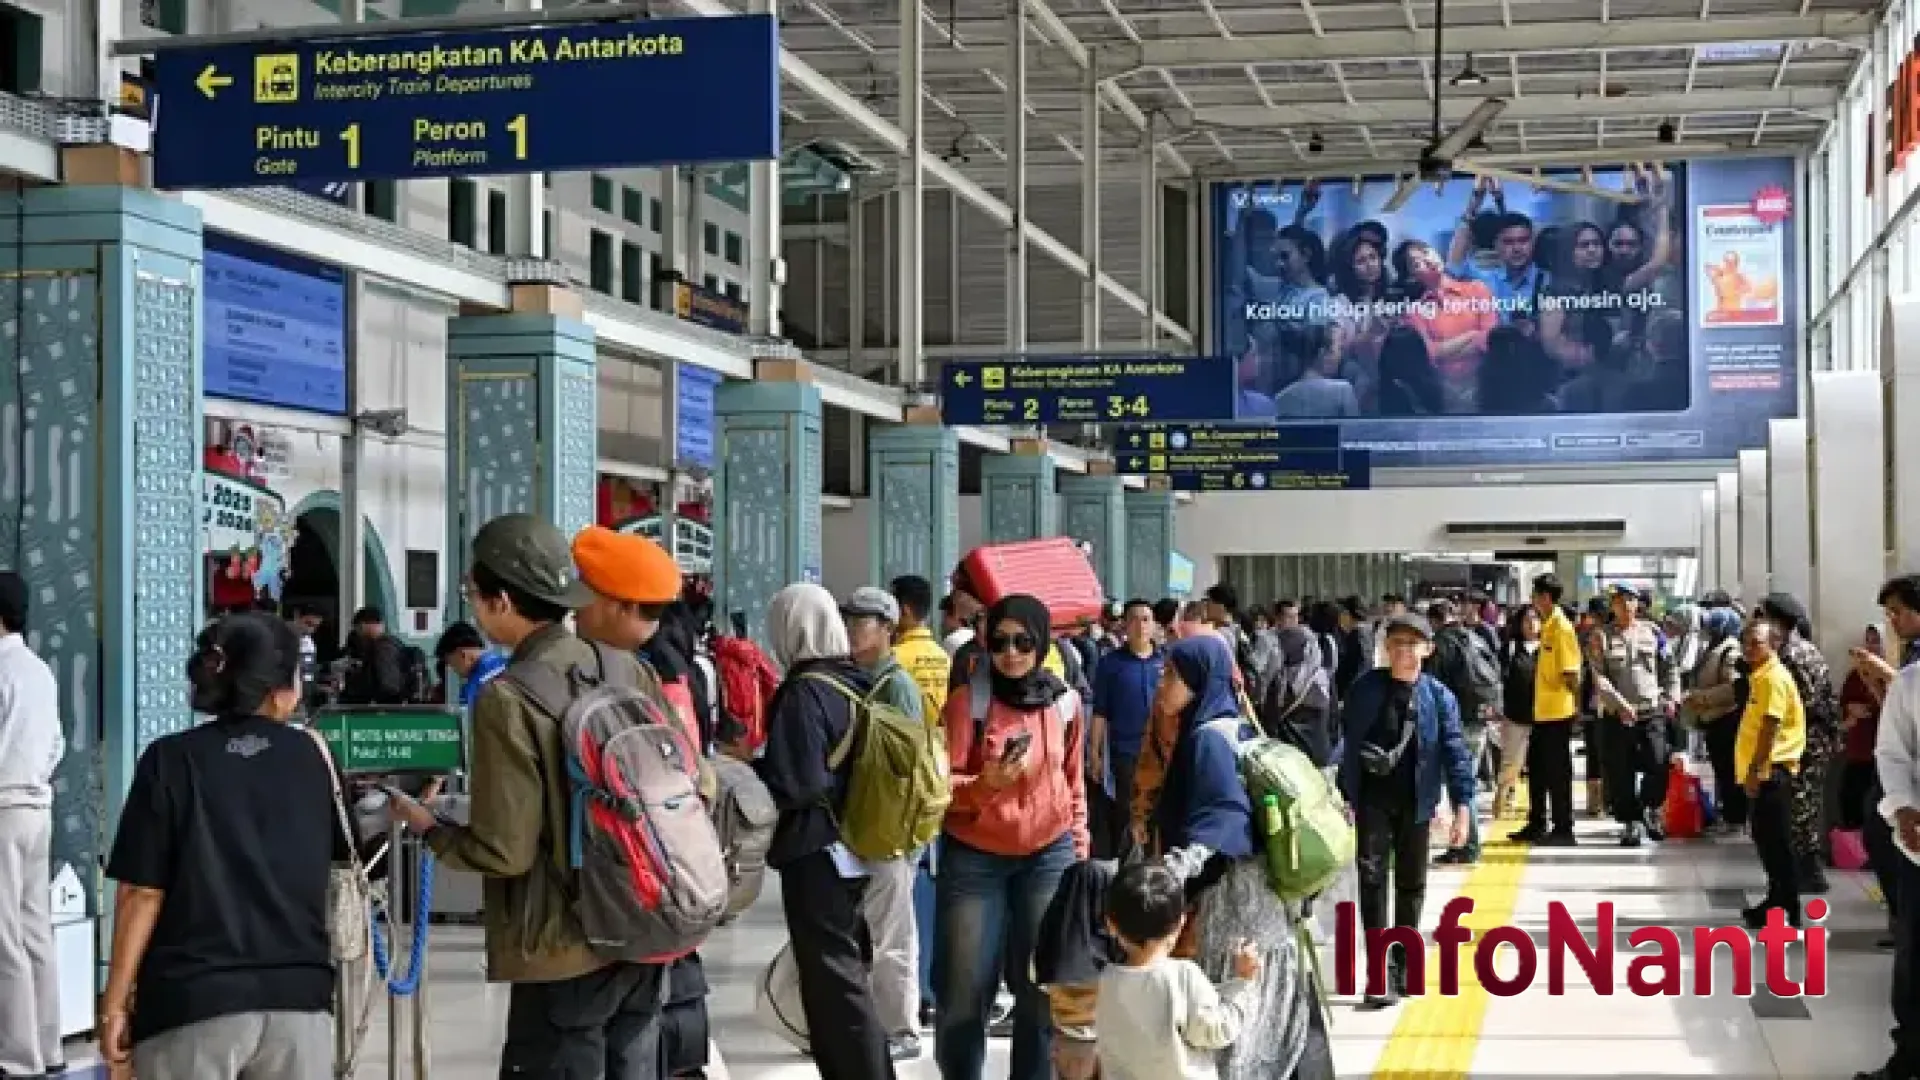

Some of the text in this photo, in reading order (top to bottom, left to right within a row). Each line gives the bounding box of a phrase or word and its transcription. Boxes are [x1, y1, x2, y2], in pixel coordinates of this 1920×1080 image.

[314, 33, 683, 75] Keberangkatan KA Antarkota
[314, 74, 534, 100] Intercity Train Departures
[256, 114, 528, 168] Pintu 1 Peron 1
[255, 149, 488, 174] Gate Platform
[1246, 288, 1667, 323] Kalau hidup sering tertekuk, lemesin aja.
[1012, 362, 1185, 379] Keberangkatan KA Antarkota
[1023, 398, 1039, 420] 2
